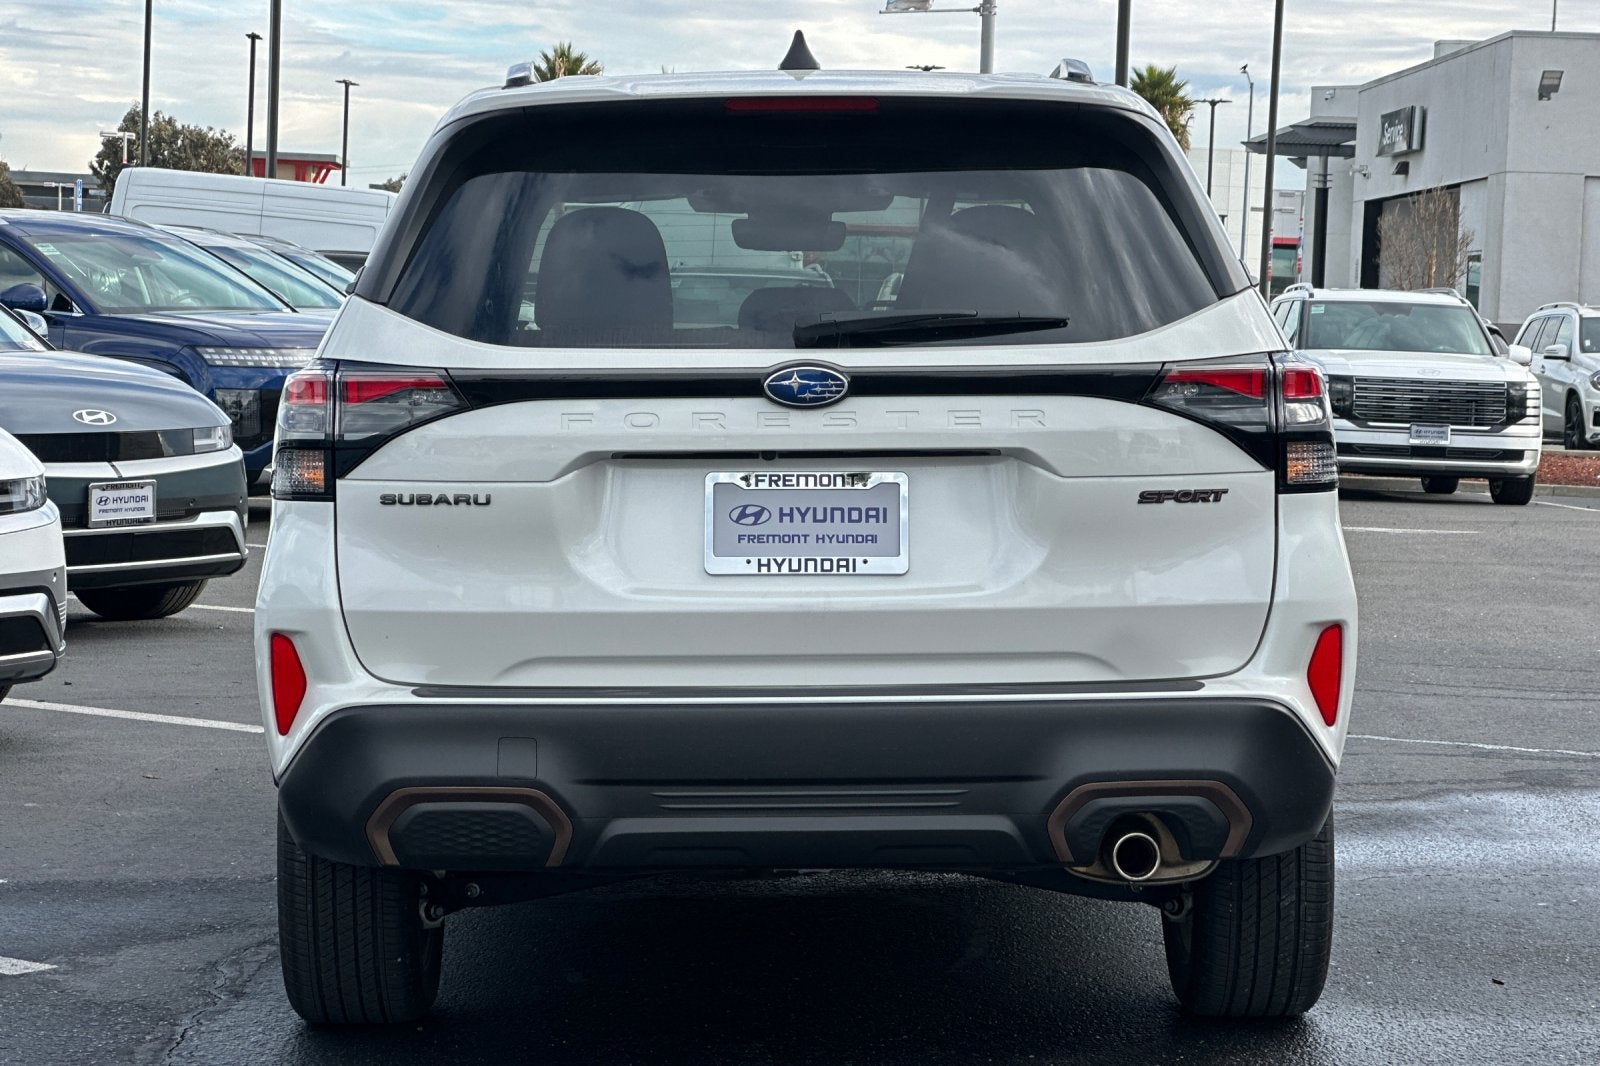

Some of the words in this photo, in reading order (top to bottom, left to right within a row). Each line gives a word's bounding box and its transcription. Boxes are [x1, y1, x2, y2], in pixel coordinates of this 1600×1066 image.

[560, 409, 1047, 431] FORESTER
[755, 473, 858, 488] FREMONT
[112, 495, 148, 504] HYUNDAI
[379, 493, 492, 506] SUBARU
[1137, 488, 1229, 504] SPORT
[778, 506, 888, 524] HYUNDAI
[737, 534, 810, 544] FREMONT
[815, 534, 878, 544] HYUNDAI
[757, 558, 857, 573] HYUNDAI
